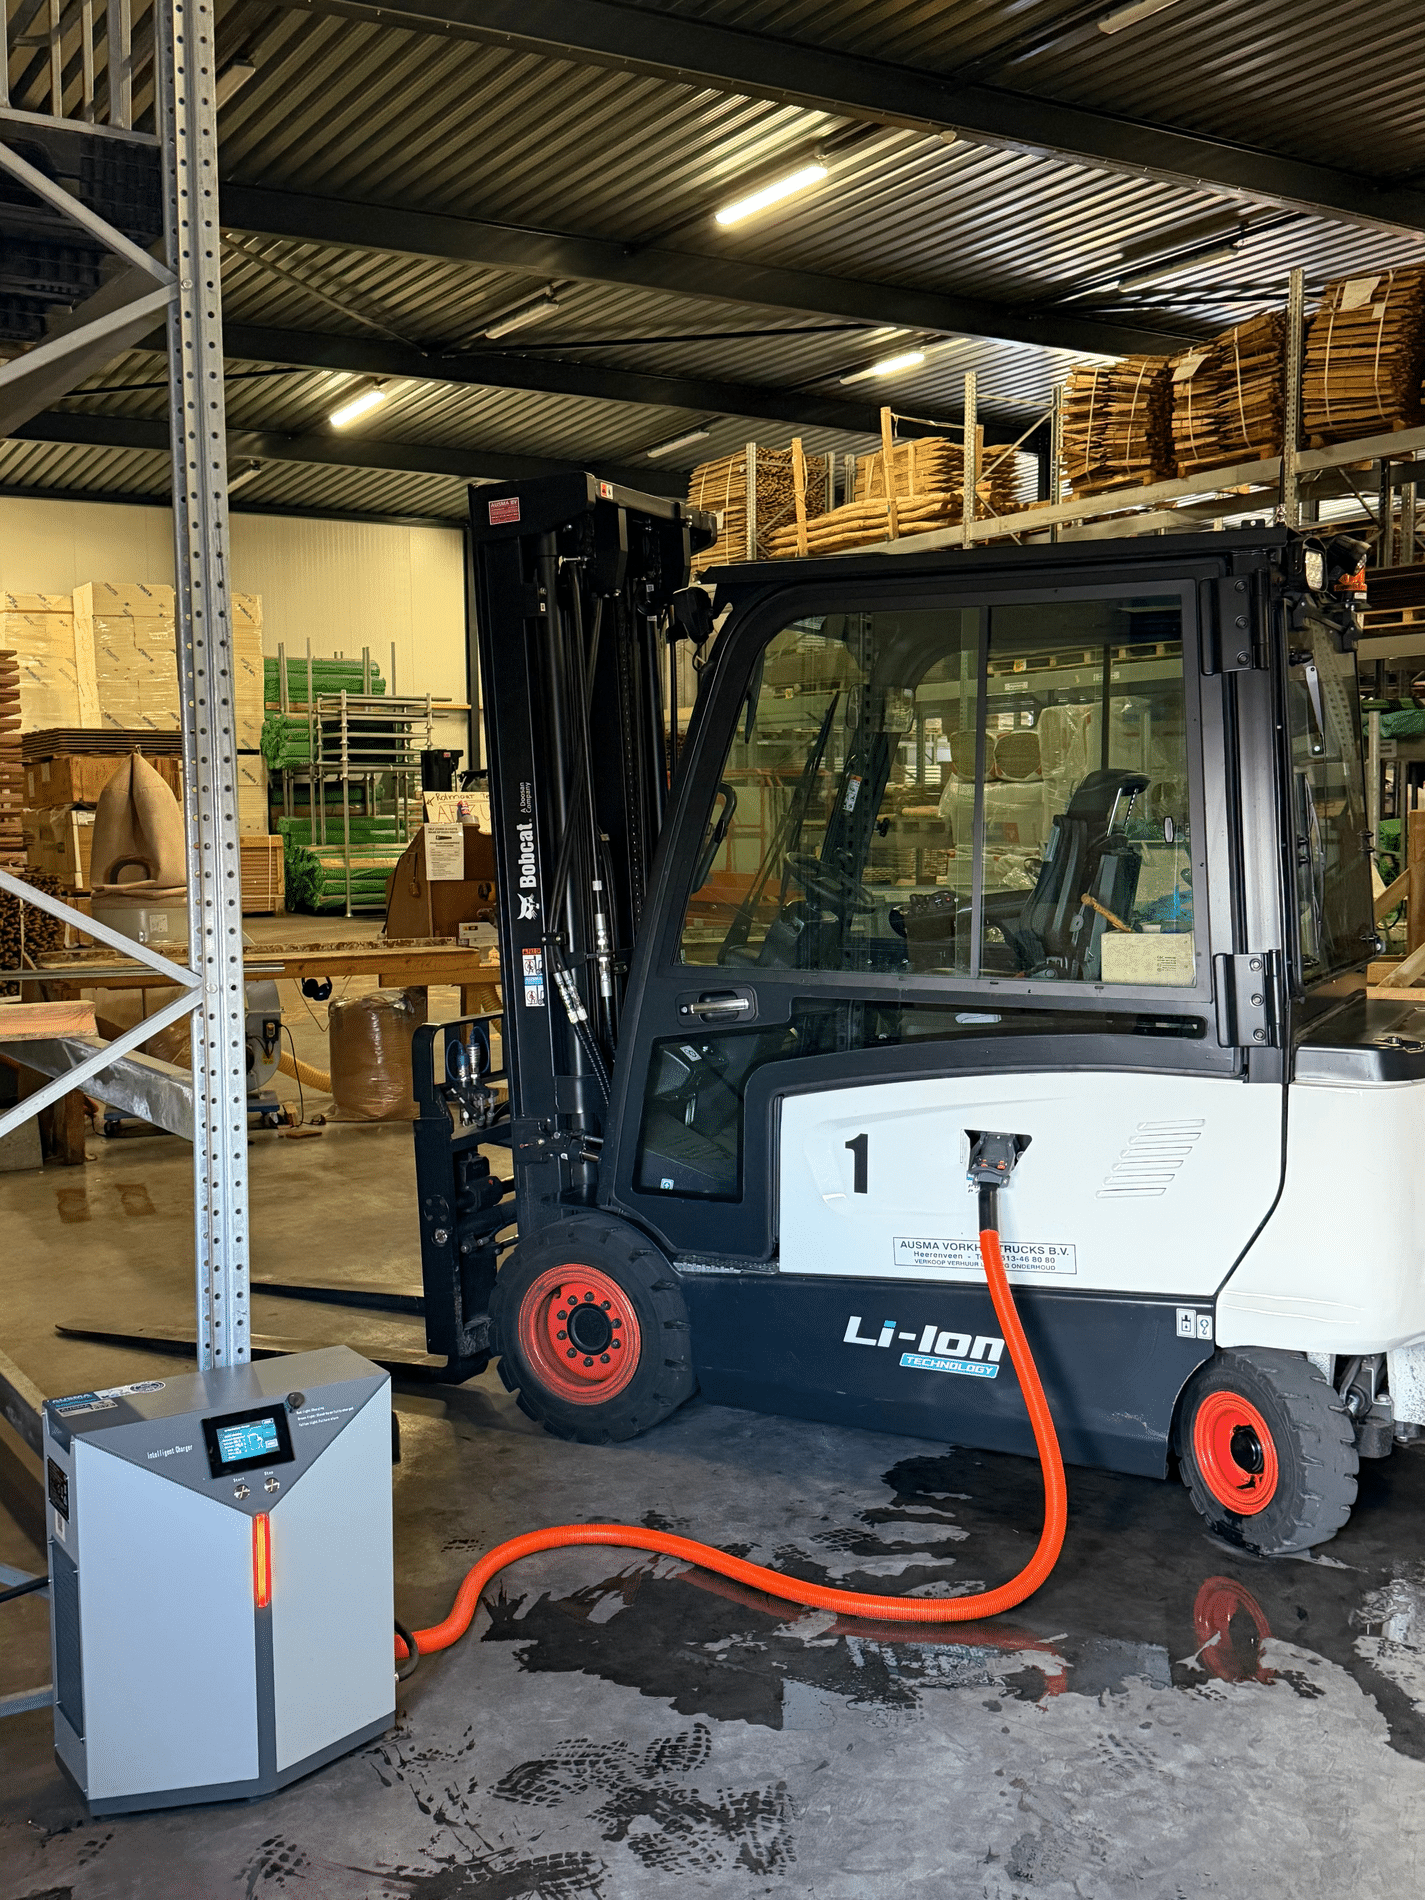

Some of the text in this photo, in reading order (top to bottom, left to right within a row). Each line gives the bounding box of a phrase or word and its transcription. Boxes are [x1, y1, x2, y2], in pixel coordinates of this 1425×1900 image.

[516, 822, 537, 888] Bobcat
[845, 1133, 868, 1193] 1
[900, 1241, 940, 1250] AUSMA
[1049, 1247, 1070, 1256] B.V.
[913, 1251, 963, 1259] Heerenveen
[843, 1315, 1005, 1362] Li-Ion
[906, 1356, 994, 1375] TECHNOLOGY
[147, 1444, 193, 1459] Intelligent Charger
